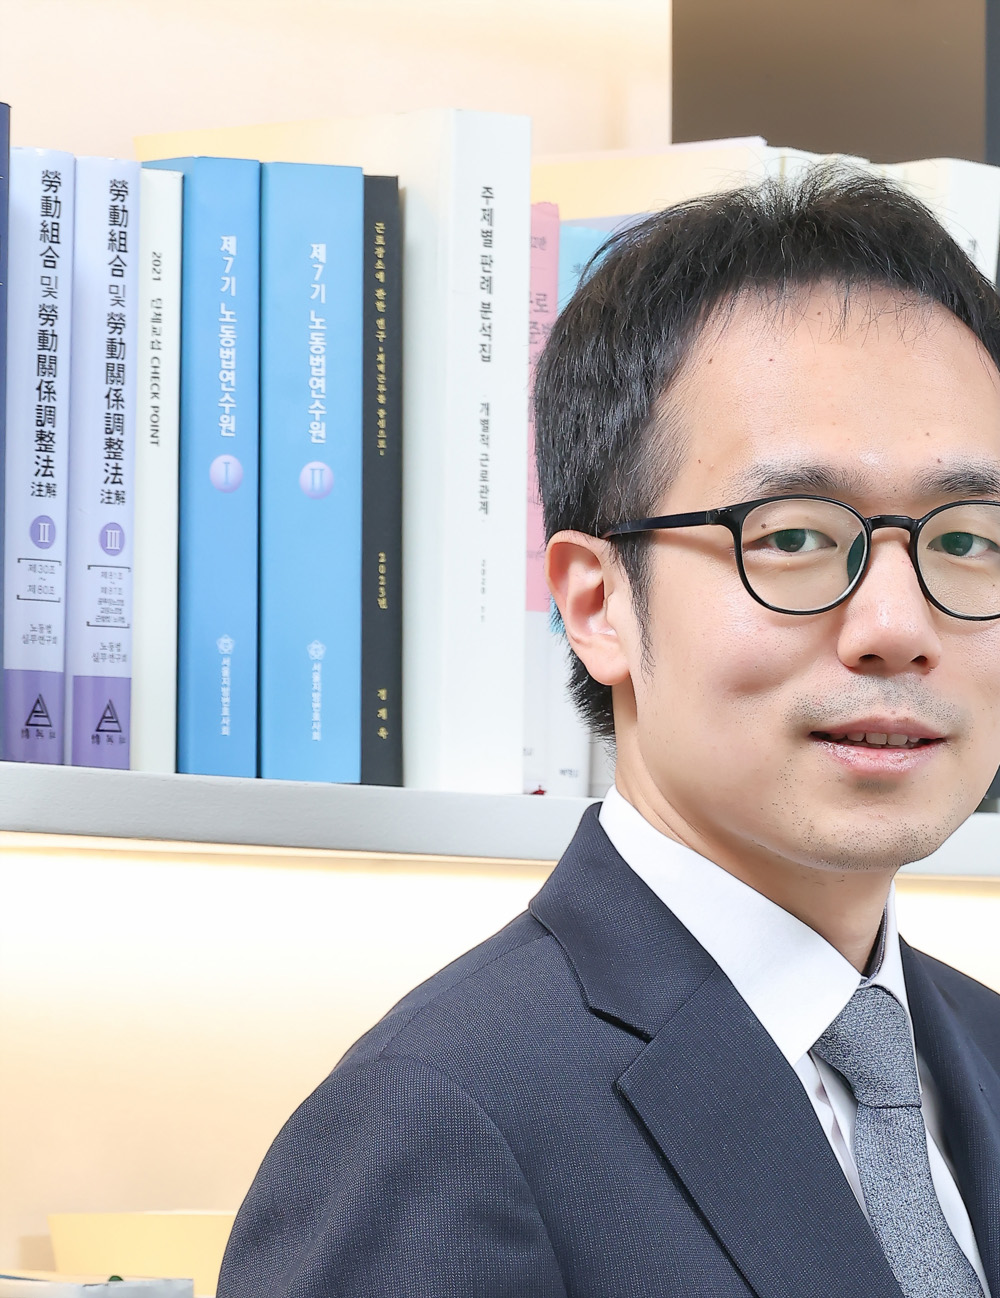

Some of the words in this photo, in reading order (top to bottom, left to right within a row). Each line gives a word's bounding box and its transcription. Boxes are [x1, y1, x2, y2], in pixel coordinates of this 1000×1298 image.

[39, 169, 62, 269] 勞動組合
[107, 179, 129, 278] 勞動組合
[40, 275, 59, 299] 및
[108, 284, 127, 308] 및
[151, 251, 162, 282] 2021
[219, 236, 238, 297] 제7기
[309, 243, 328, 303] 제7기
[34, 303, 59, 478] 勞動關係調整法
[103, 312, 127, 485] 勞動關係調整法
[150, 357, 161, 400] CHECK
[217, 303, 238, 437] 노동법연수원
[308, 310, 328, 444] 노동법연수원
[149, 406, 161, 447] POINT
